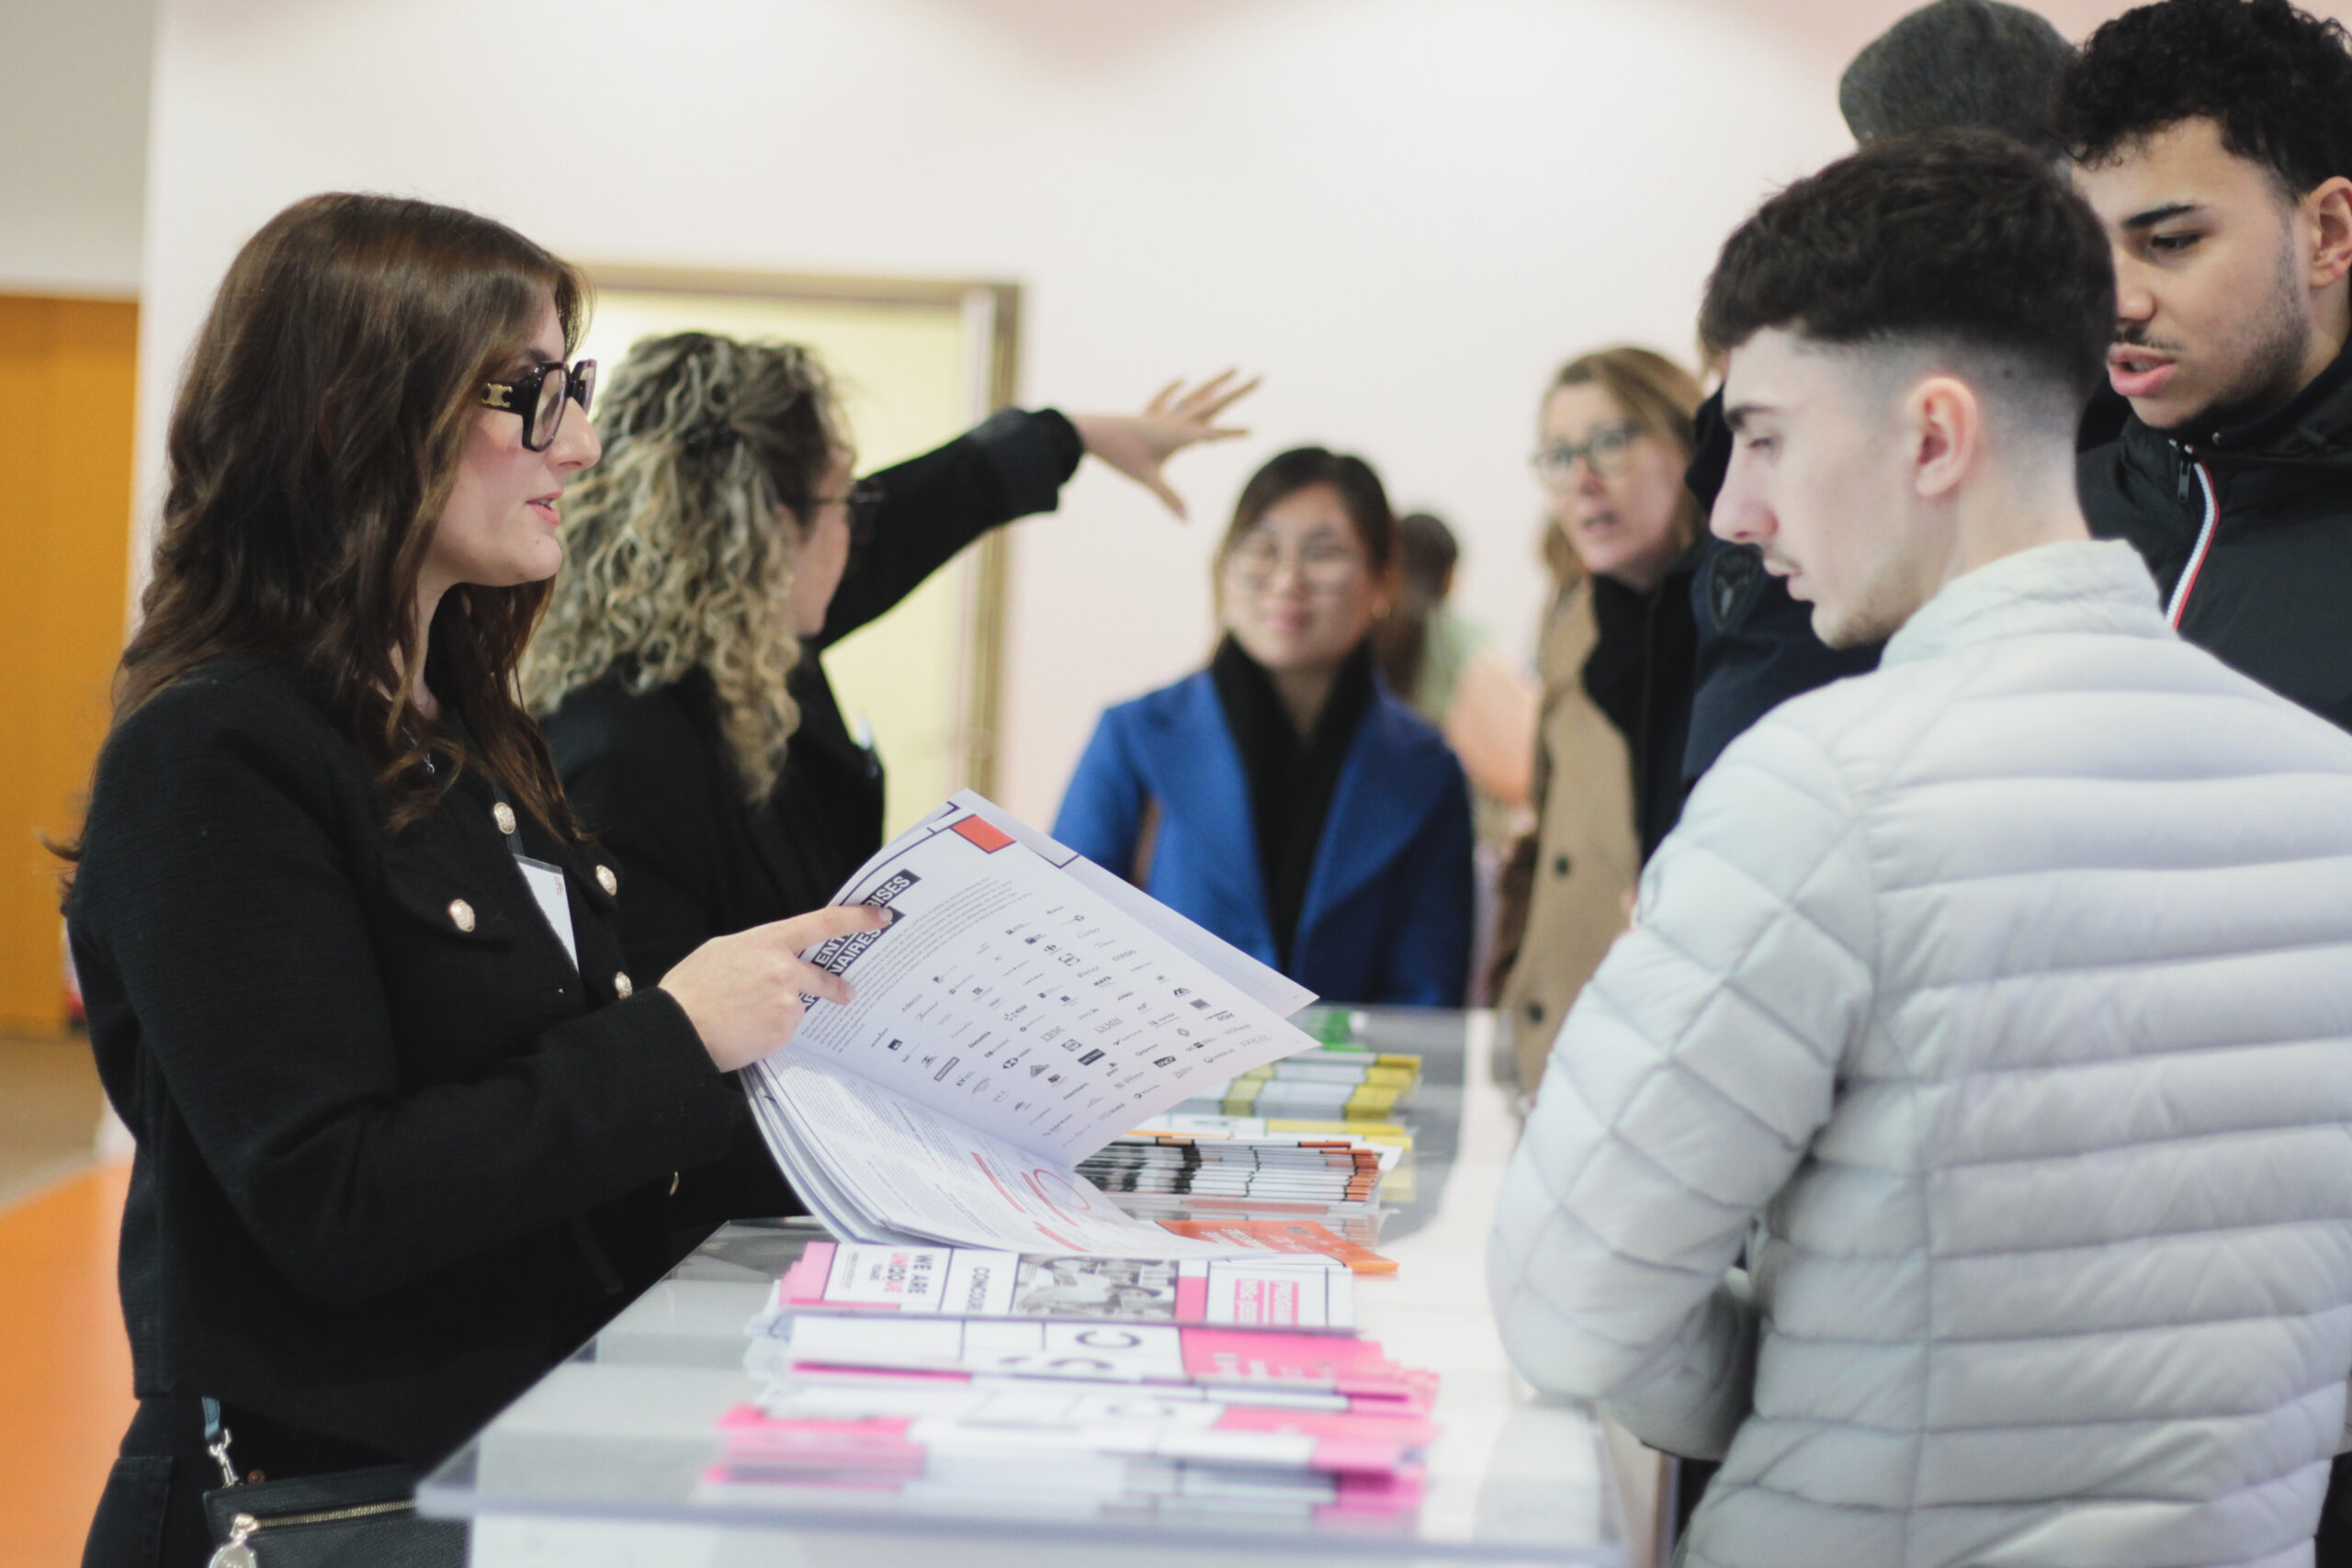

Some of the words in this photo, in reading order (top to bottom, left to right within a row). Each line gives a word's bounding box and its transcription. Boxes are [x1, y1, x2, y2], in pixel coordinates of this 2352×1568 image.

[815, 875, 911, 964] ENTRISES
[913, 1254, 934, 1269] WE
[908, 1274, 929, 1293] ARE
